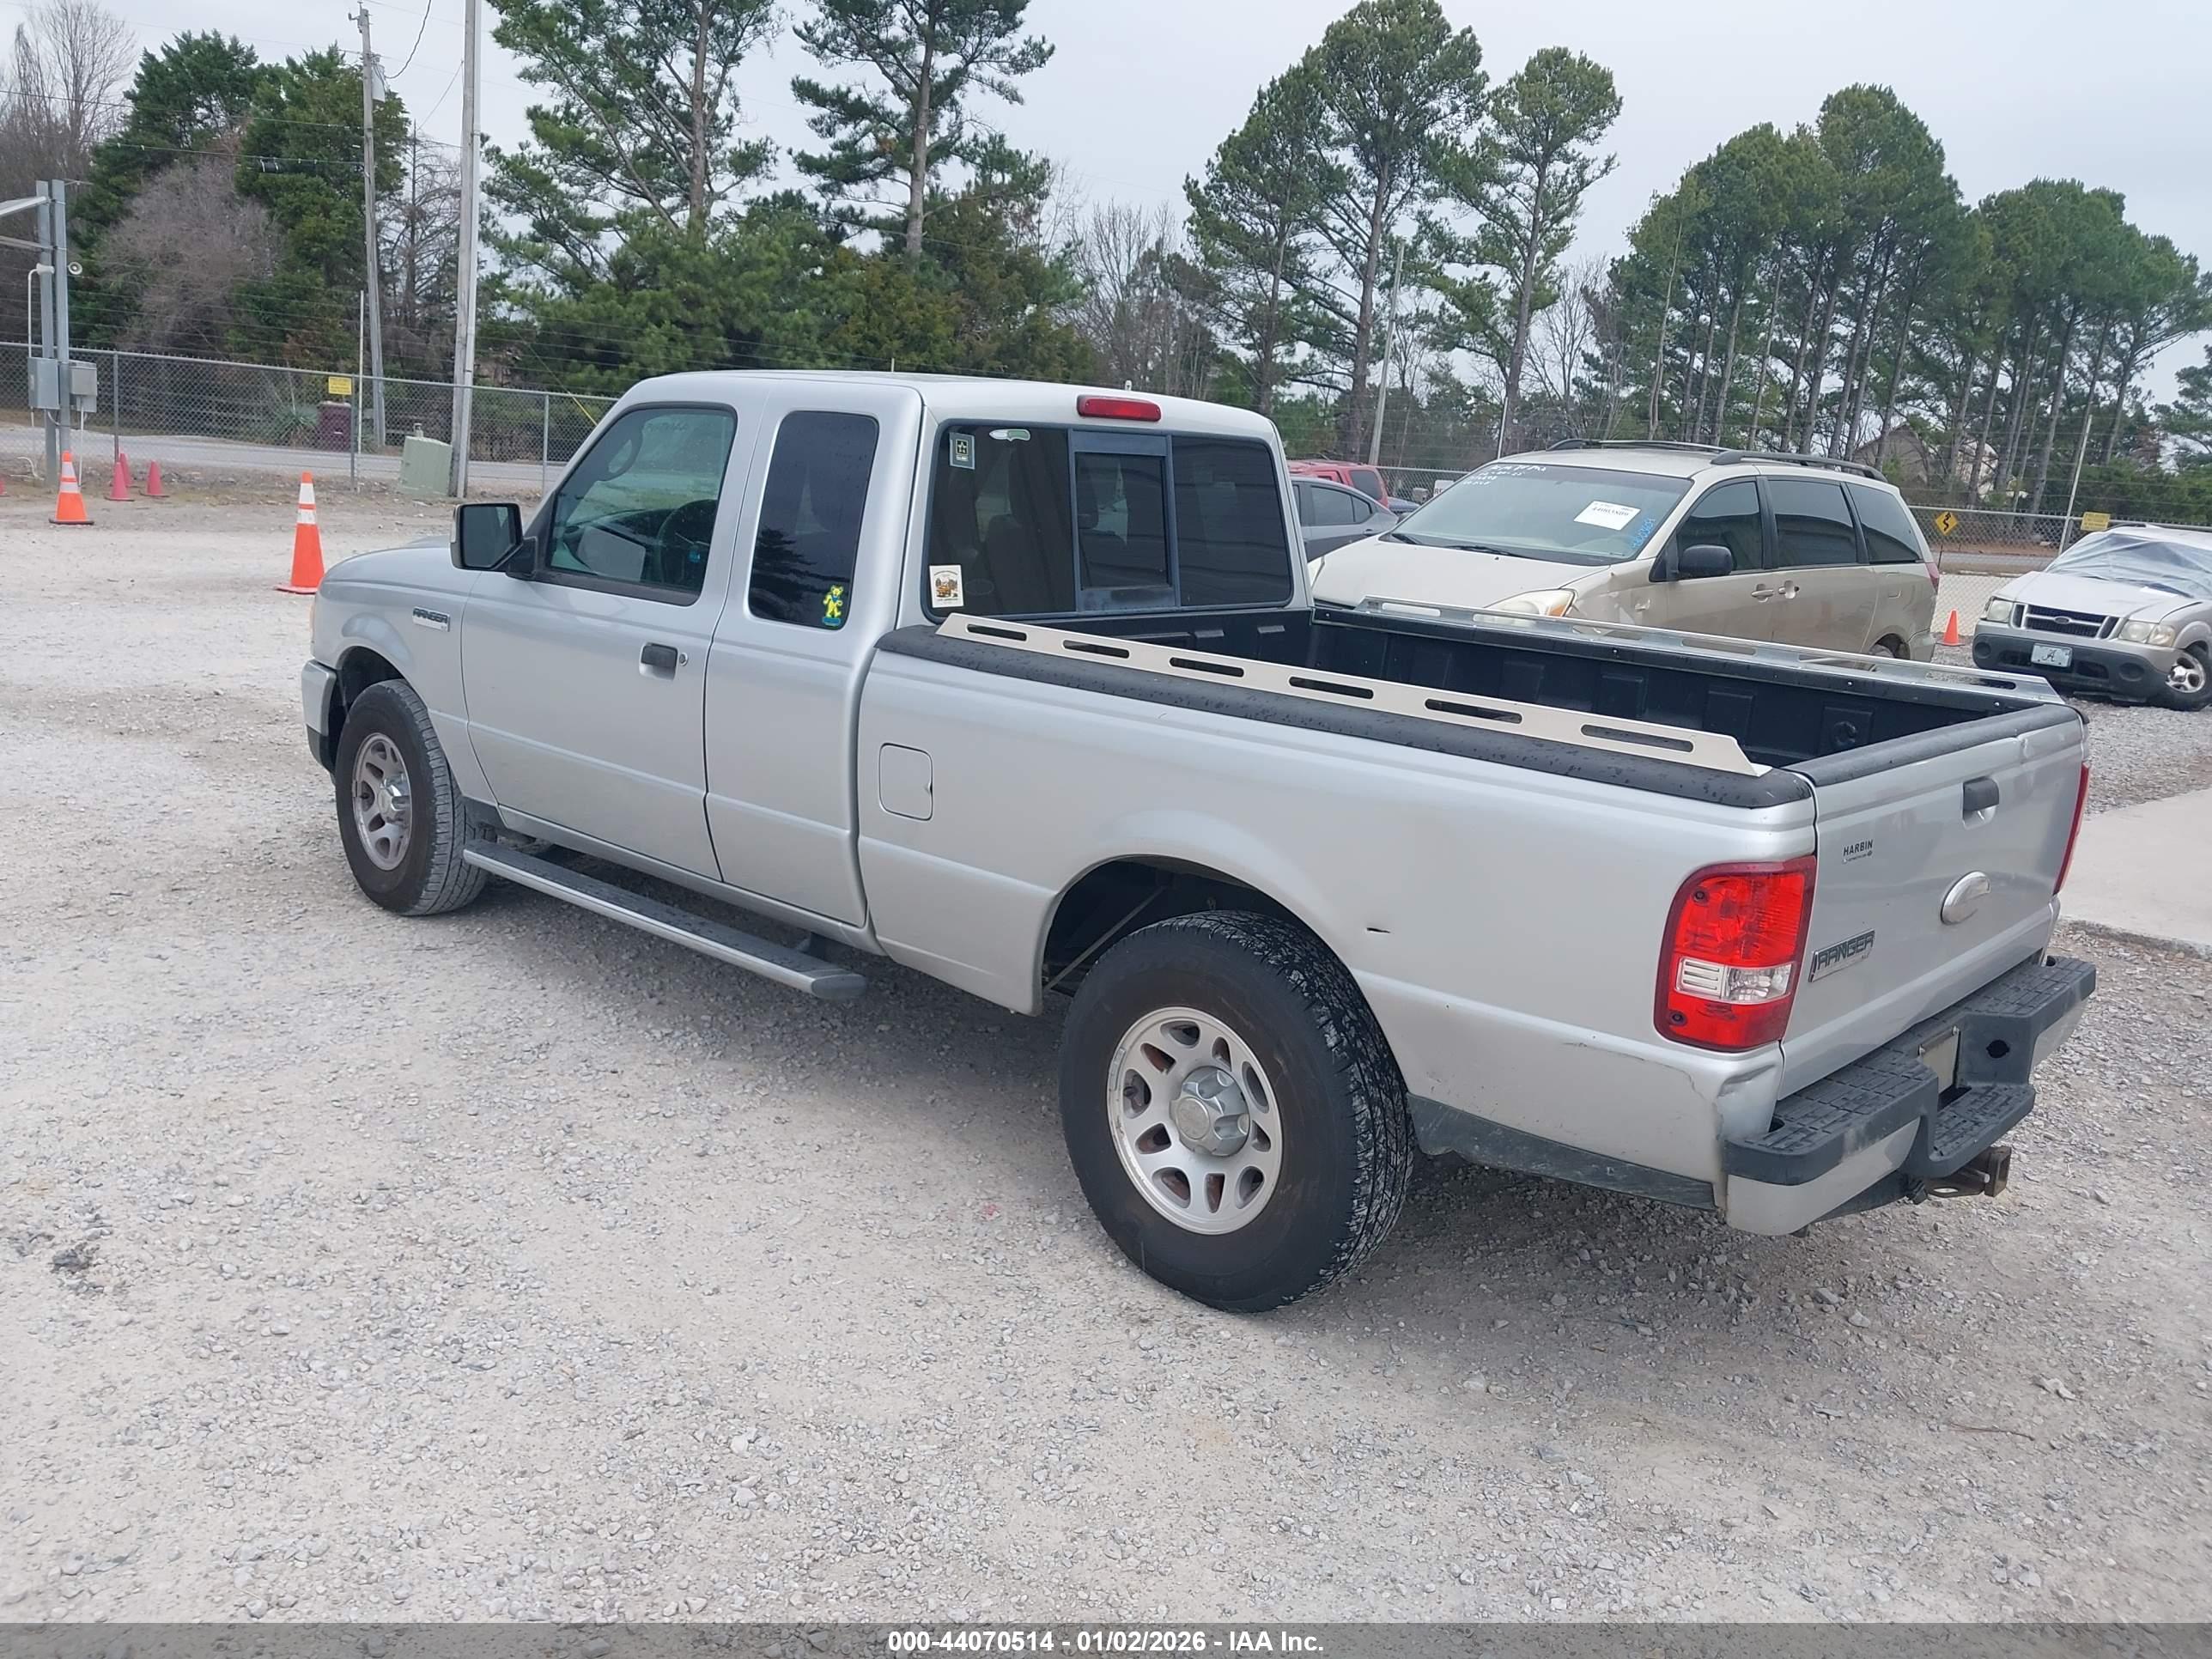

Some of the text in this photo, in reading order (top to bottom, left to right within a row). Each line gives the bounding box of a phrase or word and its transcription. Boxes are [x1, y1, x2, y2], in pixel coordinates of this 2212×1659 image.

[413, 607, 448, 624] RANGER
[1843, 839, 1874, 857] HARBIN
[1816, 930, 1875, 971] RANGER
